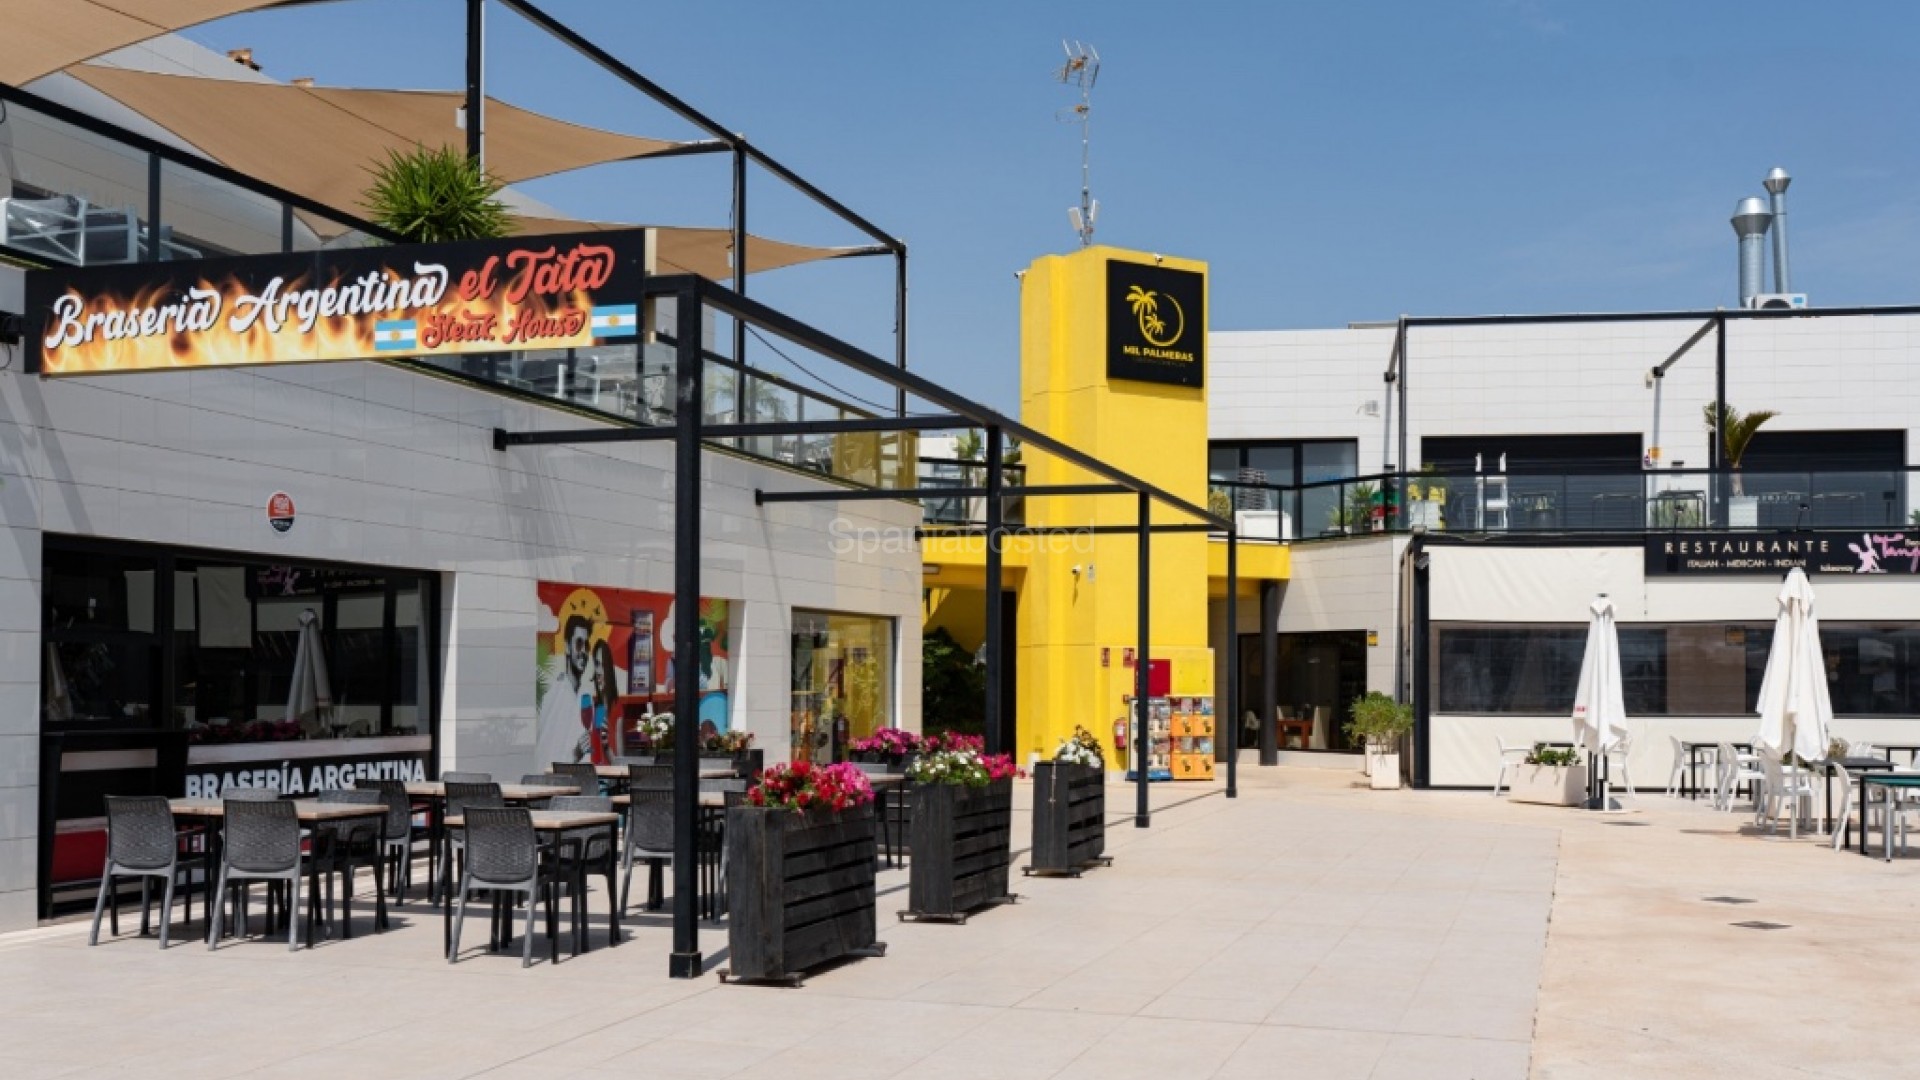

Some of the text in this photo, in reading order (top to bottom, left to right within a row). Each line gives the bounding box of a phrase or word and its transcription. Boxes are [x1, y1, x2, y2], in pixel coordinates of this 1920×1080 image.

[45, 243, 616, 349] Braseria Argentina el Tata
[422, 307, 586, 349] Steak House
[1123, 345, 1193, 361] MIL PALMERAS
[1664, 540, 1829, 554] RESTAURANTE
[1686, 559, 1719, 568] ITALIAN
[1726, 559, 1767, 568] MEXICAN
[185, 757, 427, 800] BRASERÍA ARGENTINA
